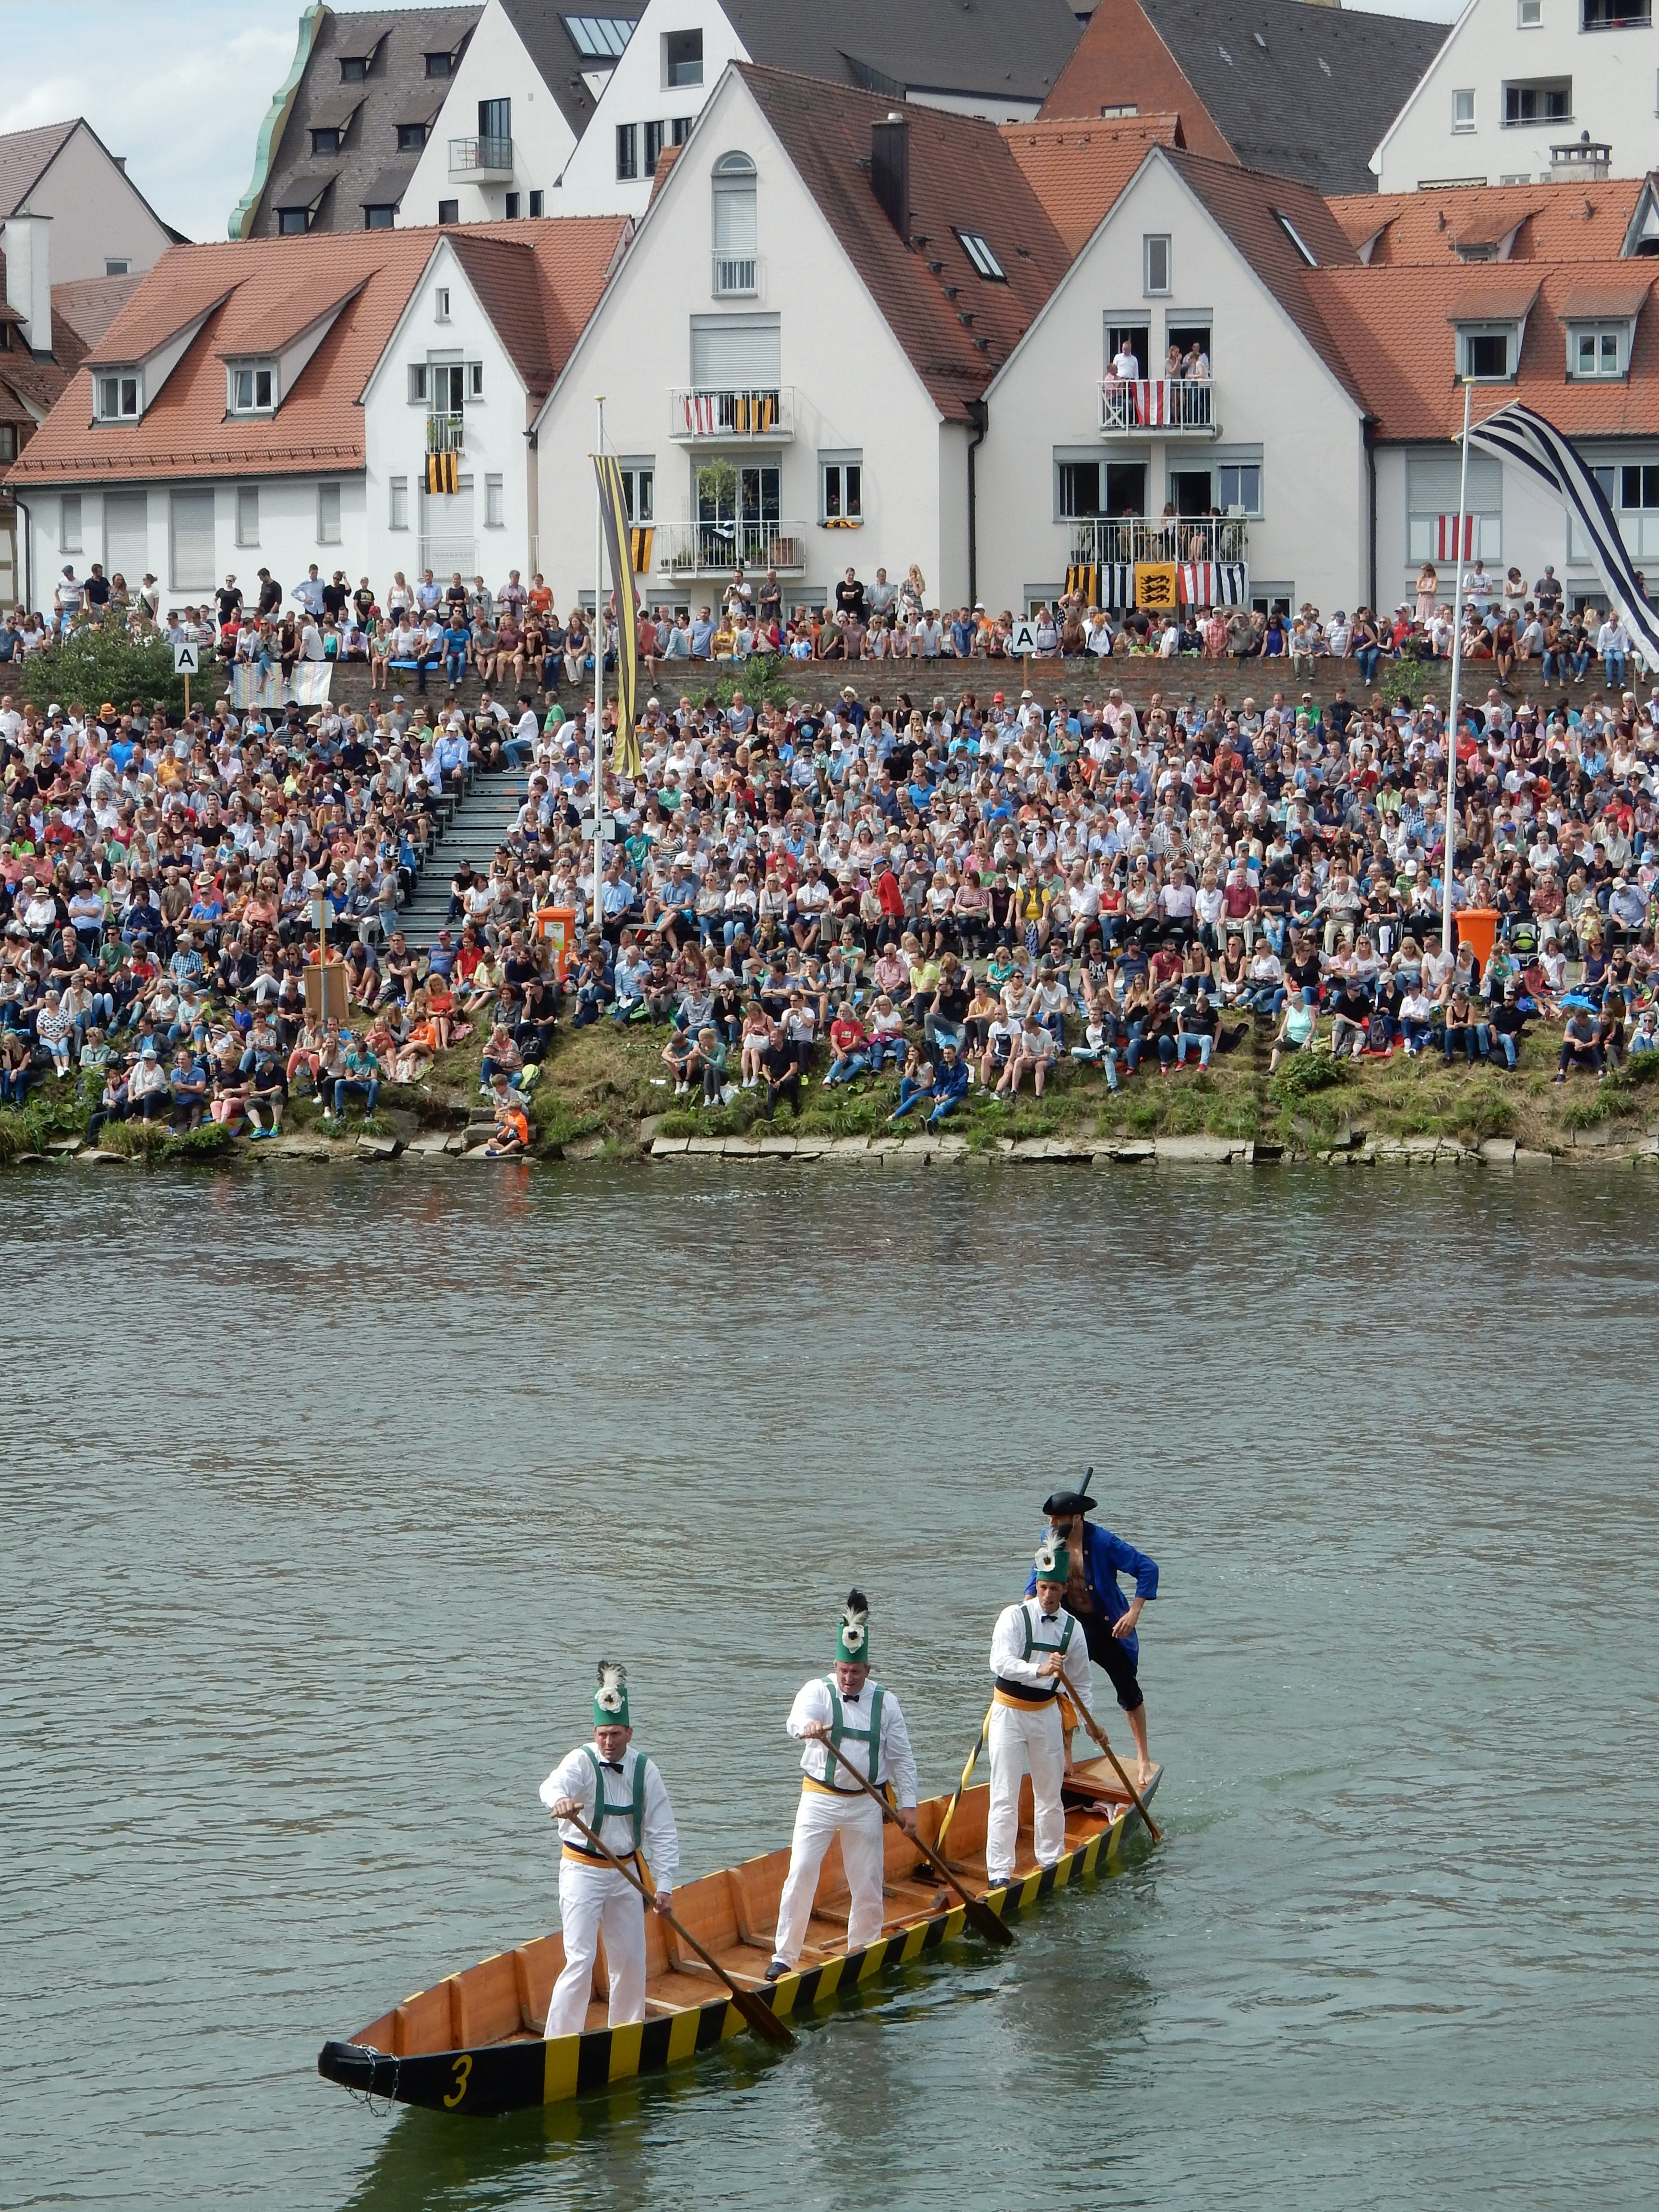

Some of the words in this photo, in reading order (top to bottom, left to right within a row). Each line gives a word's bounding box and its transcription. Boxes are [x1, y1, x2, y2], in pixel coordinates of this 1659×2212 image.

[1016, 627, 1034, 646] A
[178, 649, 194, 667] A
[444, 2055, 472, 2107] 3
